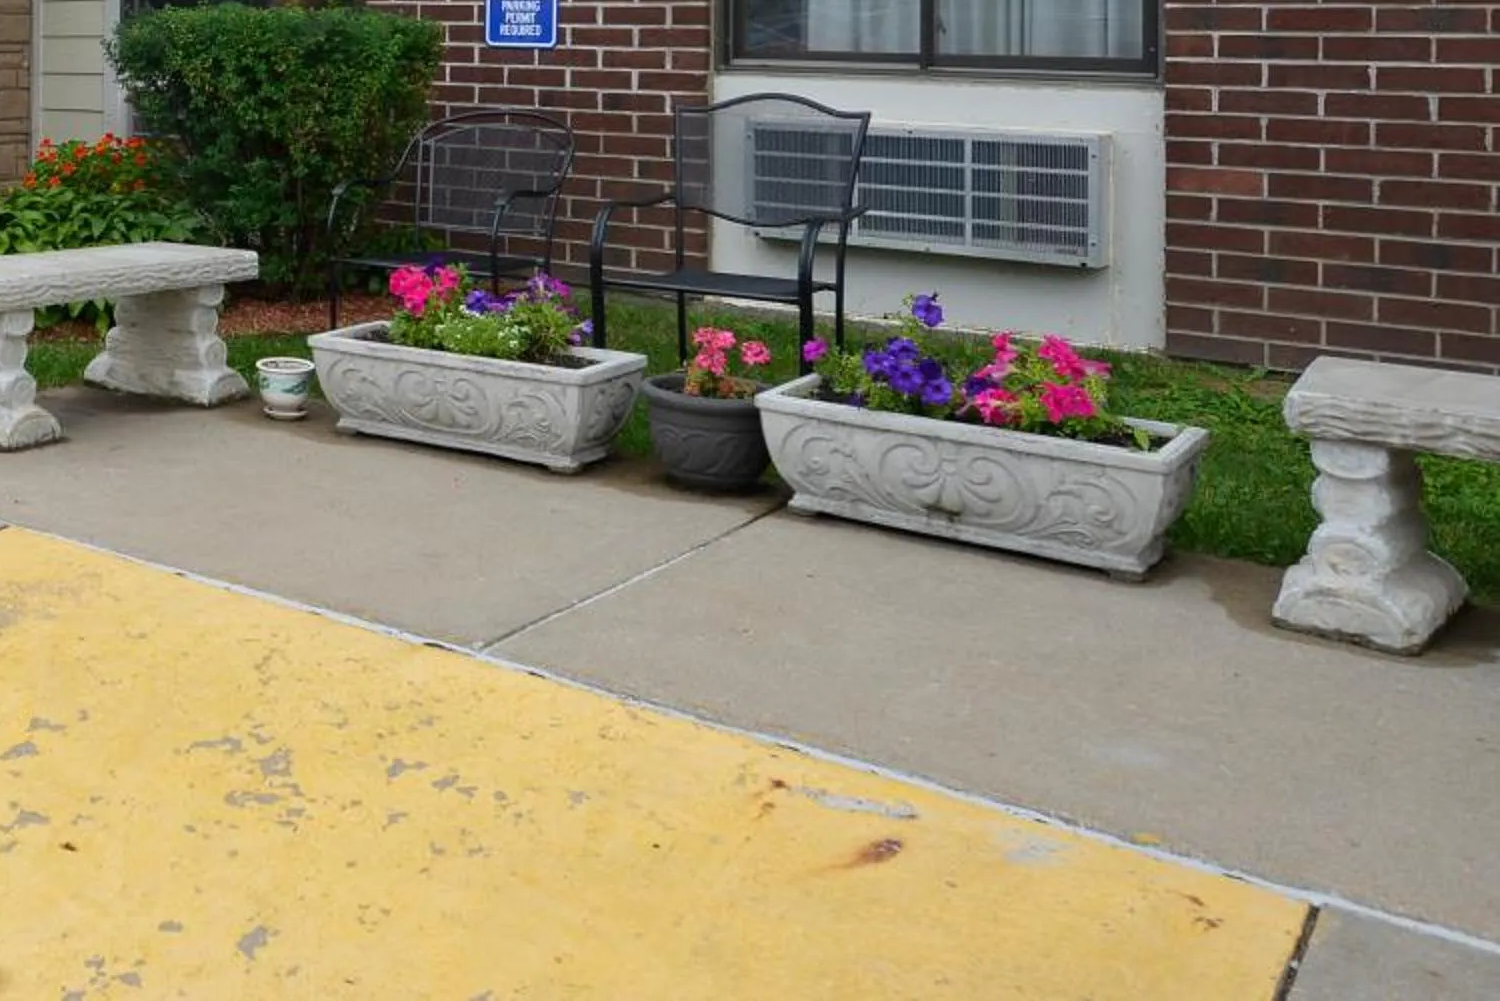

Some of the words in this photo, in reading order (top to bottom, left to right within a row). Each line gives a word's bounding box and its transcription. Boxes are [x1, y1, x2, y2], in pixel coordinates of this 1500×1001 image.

[501, 0, 541, 12] PARKING
[505, 12, 536, 24] PERMIT
[499, 24, 543, 36] REQUIRED
